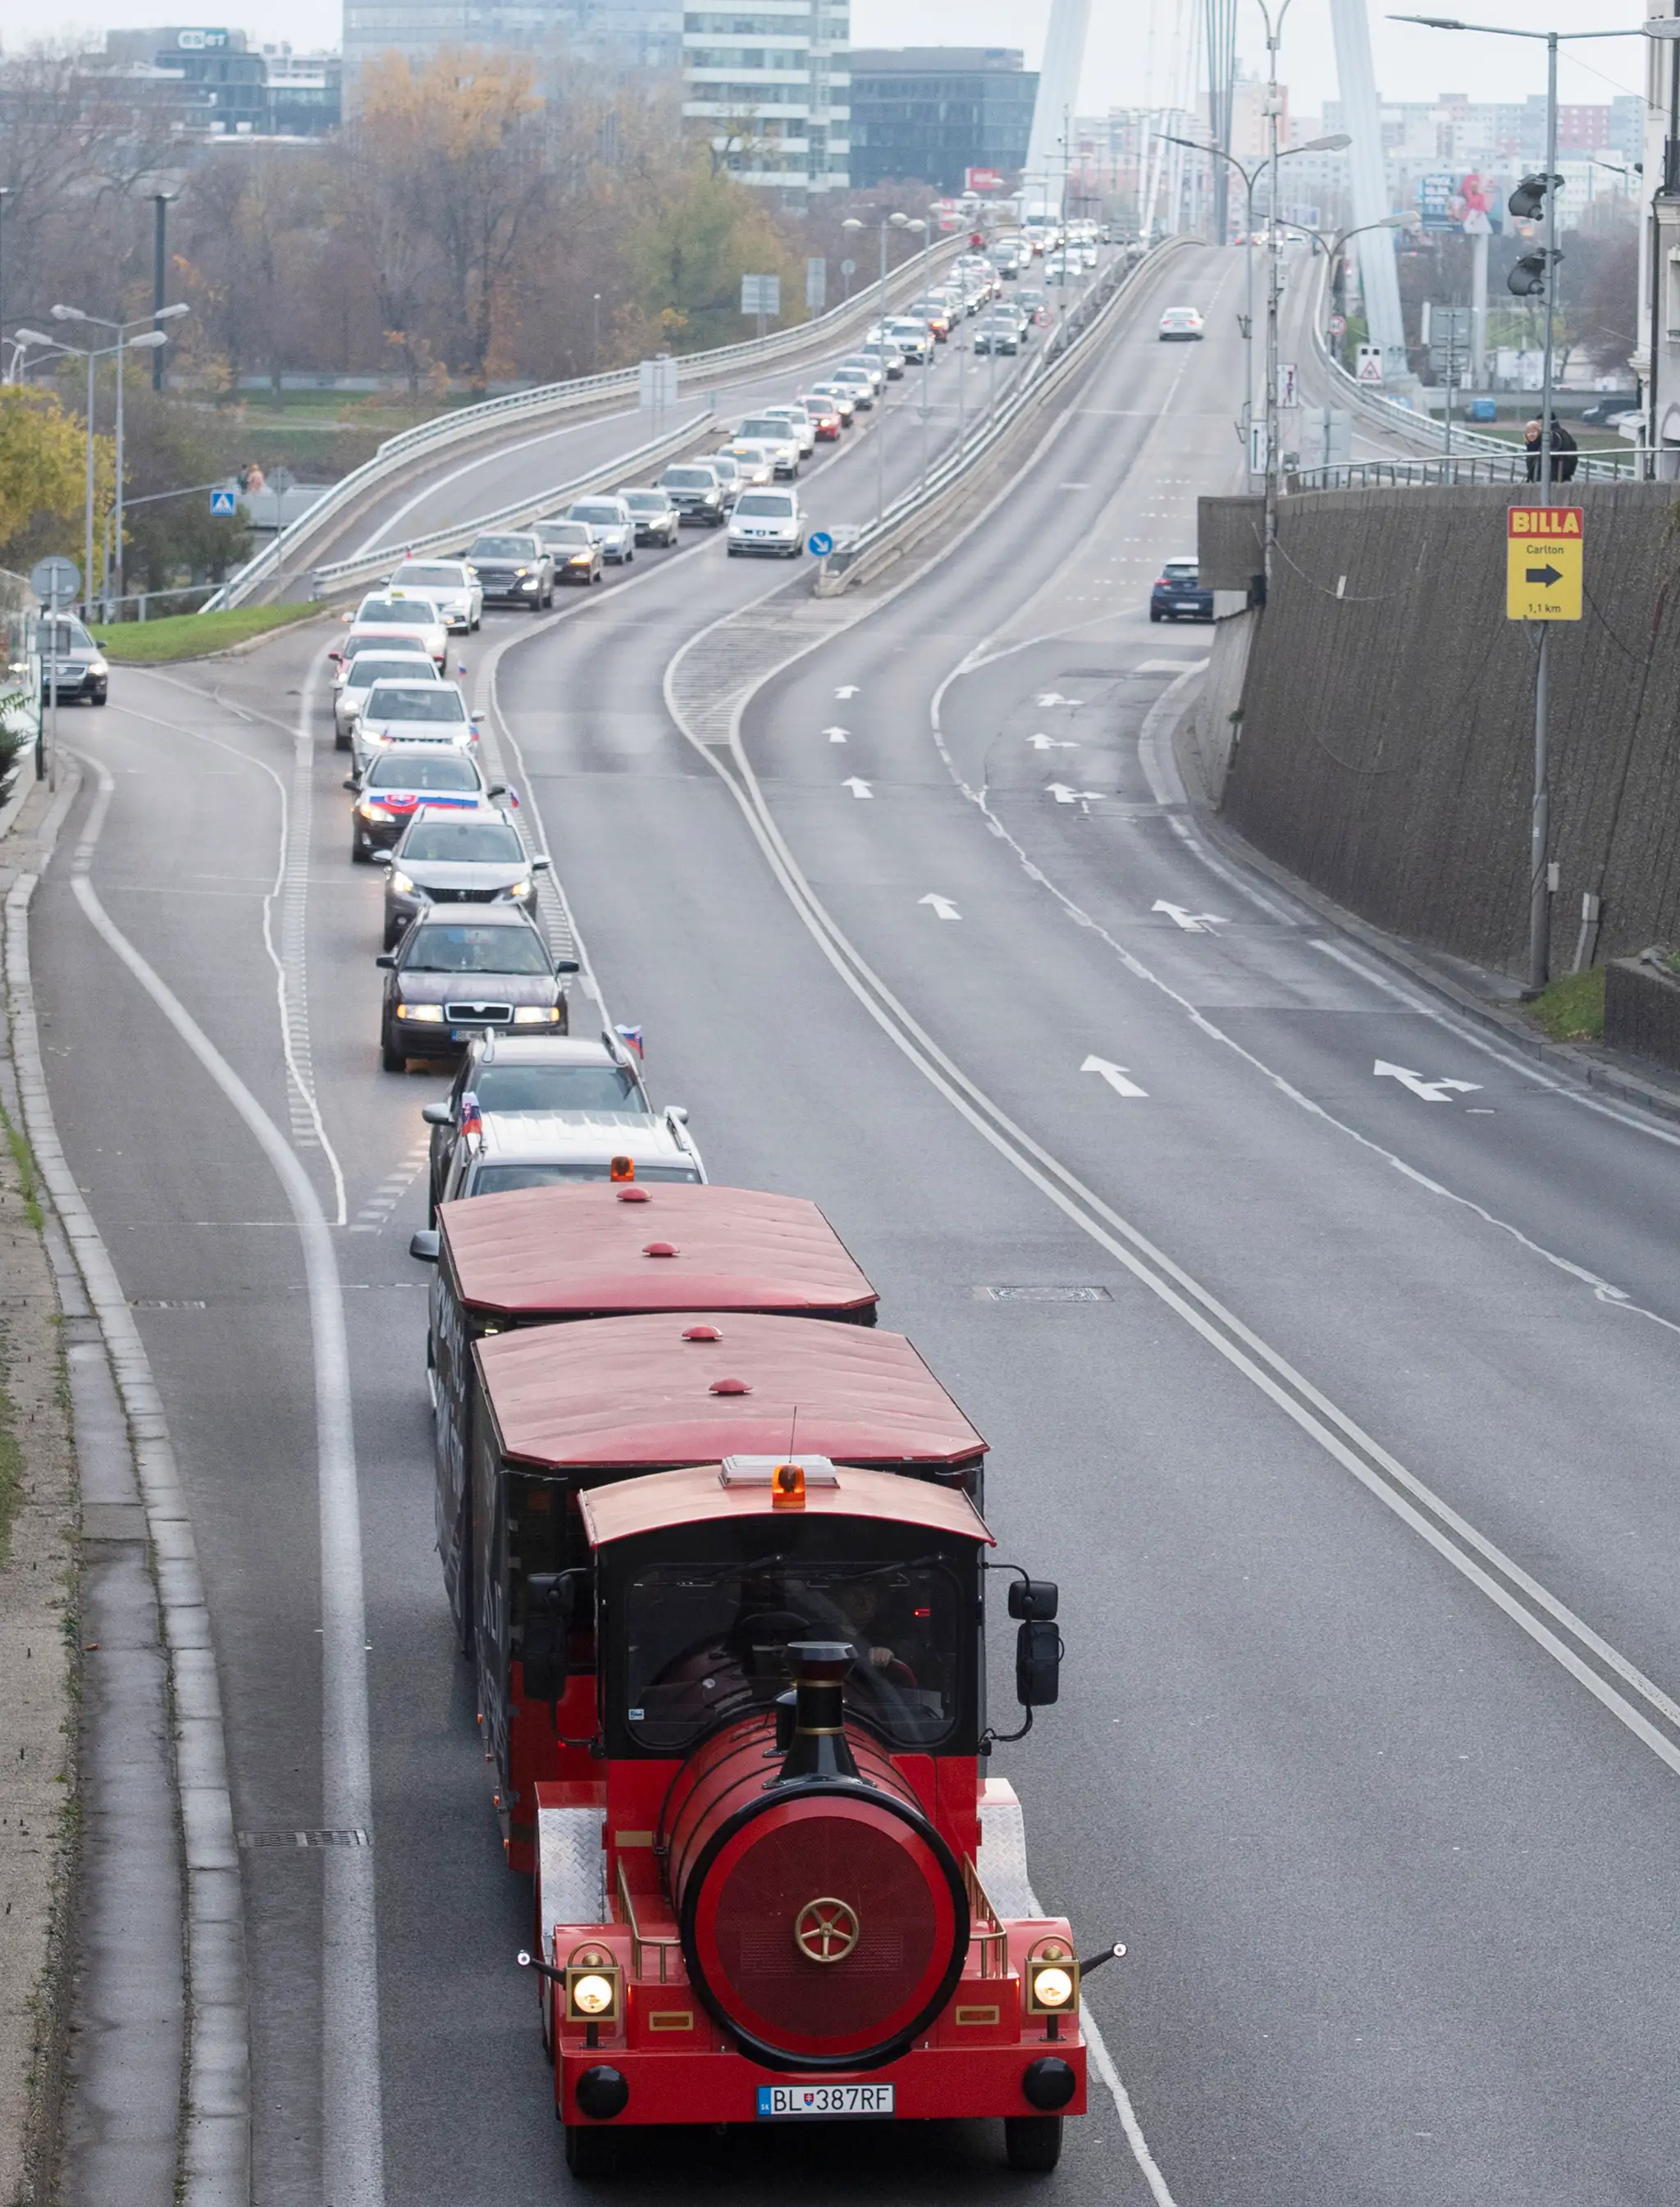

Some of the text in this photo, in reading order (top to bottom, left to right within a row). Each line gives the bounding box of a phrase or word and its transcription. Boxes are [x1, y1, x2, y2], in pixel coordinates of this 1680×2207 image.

[1513, 512, 1579, 533] BILLA
[1527, 545, 1564, 555] Carlton
[1545, 604, 1561, 614] km
[774, 2088, 889, 2112] BL 387RF
